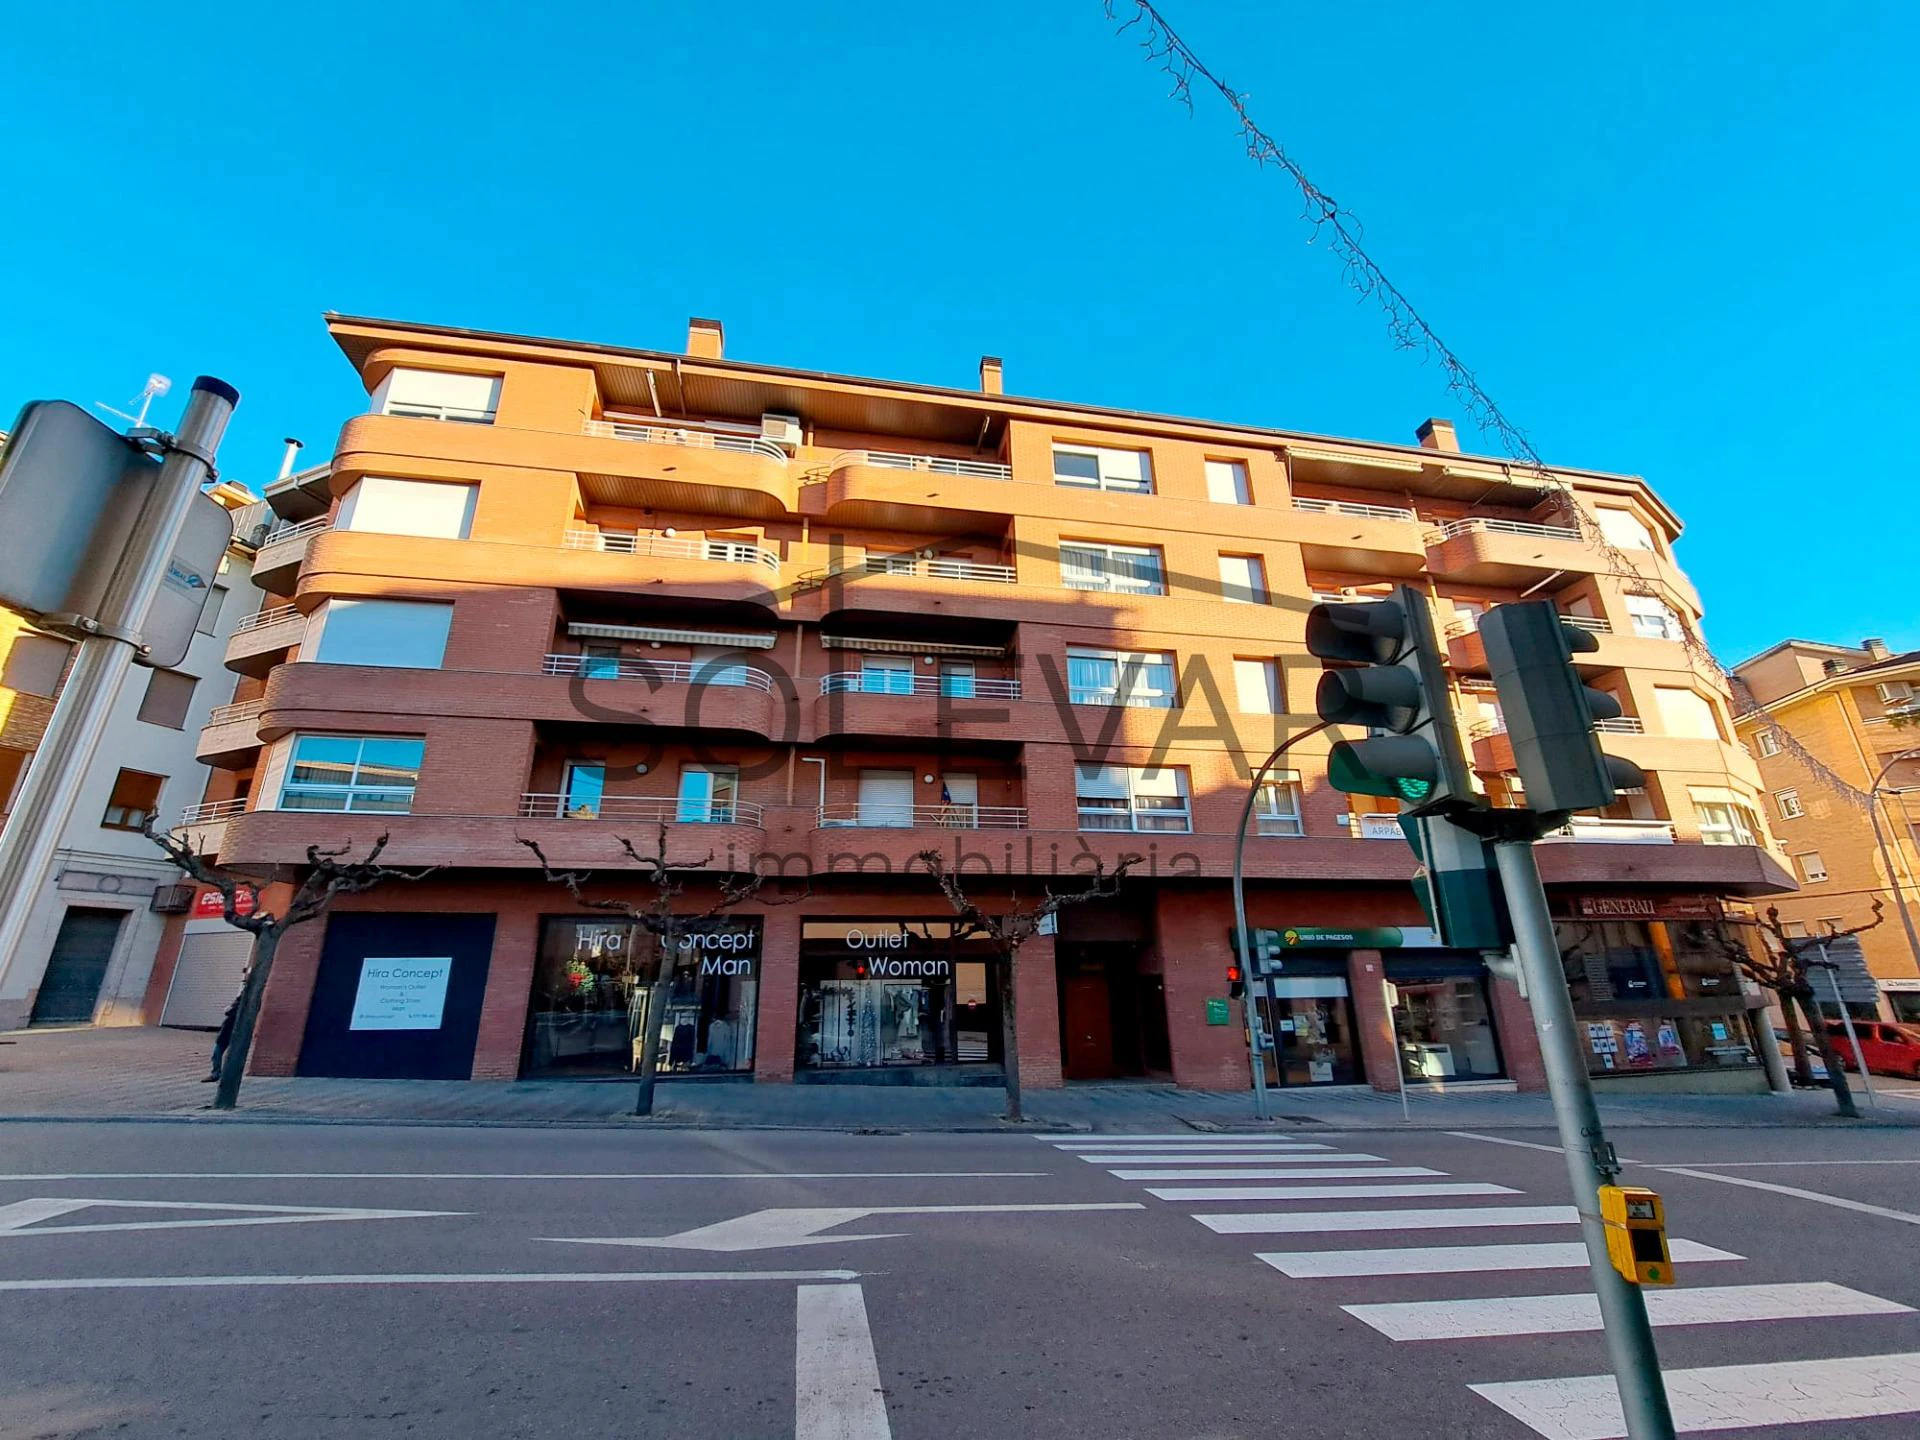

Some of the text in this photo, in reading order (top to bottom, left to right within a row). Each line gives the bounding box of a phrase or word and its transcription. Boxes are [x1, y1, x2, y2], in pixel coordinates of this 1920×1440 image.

[1592, 899, 1657, 914] GENERALI
[578, 929, 622, 950] Hira
[846, 929, 910, 949] Outlet
[367, 968, 444, 980] Hira Concept
[701, 956, 750, 976] Man
[868, 956, 949, 977] Woman
